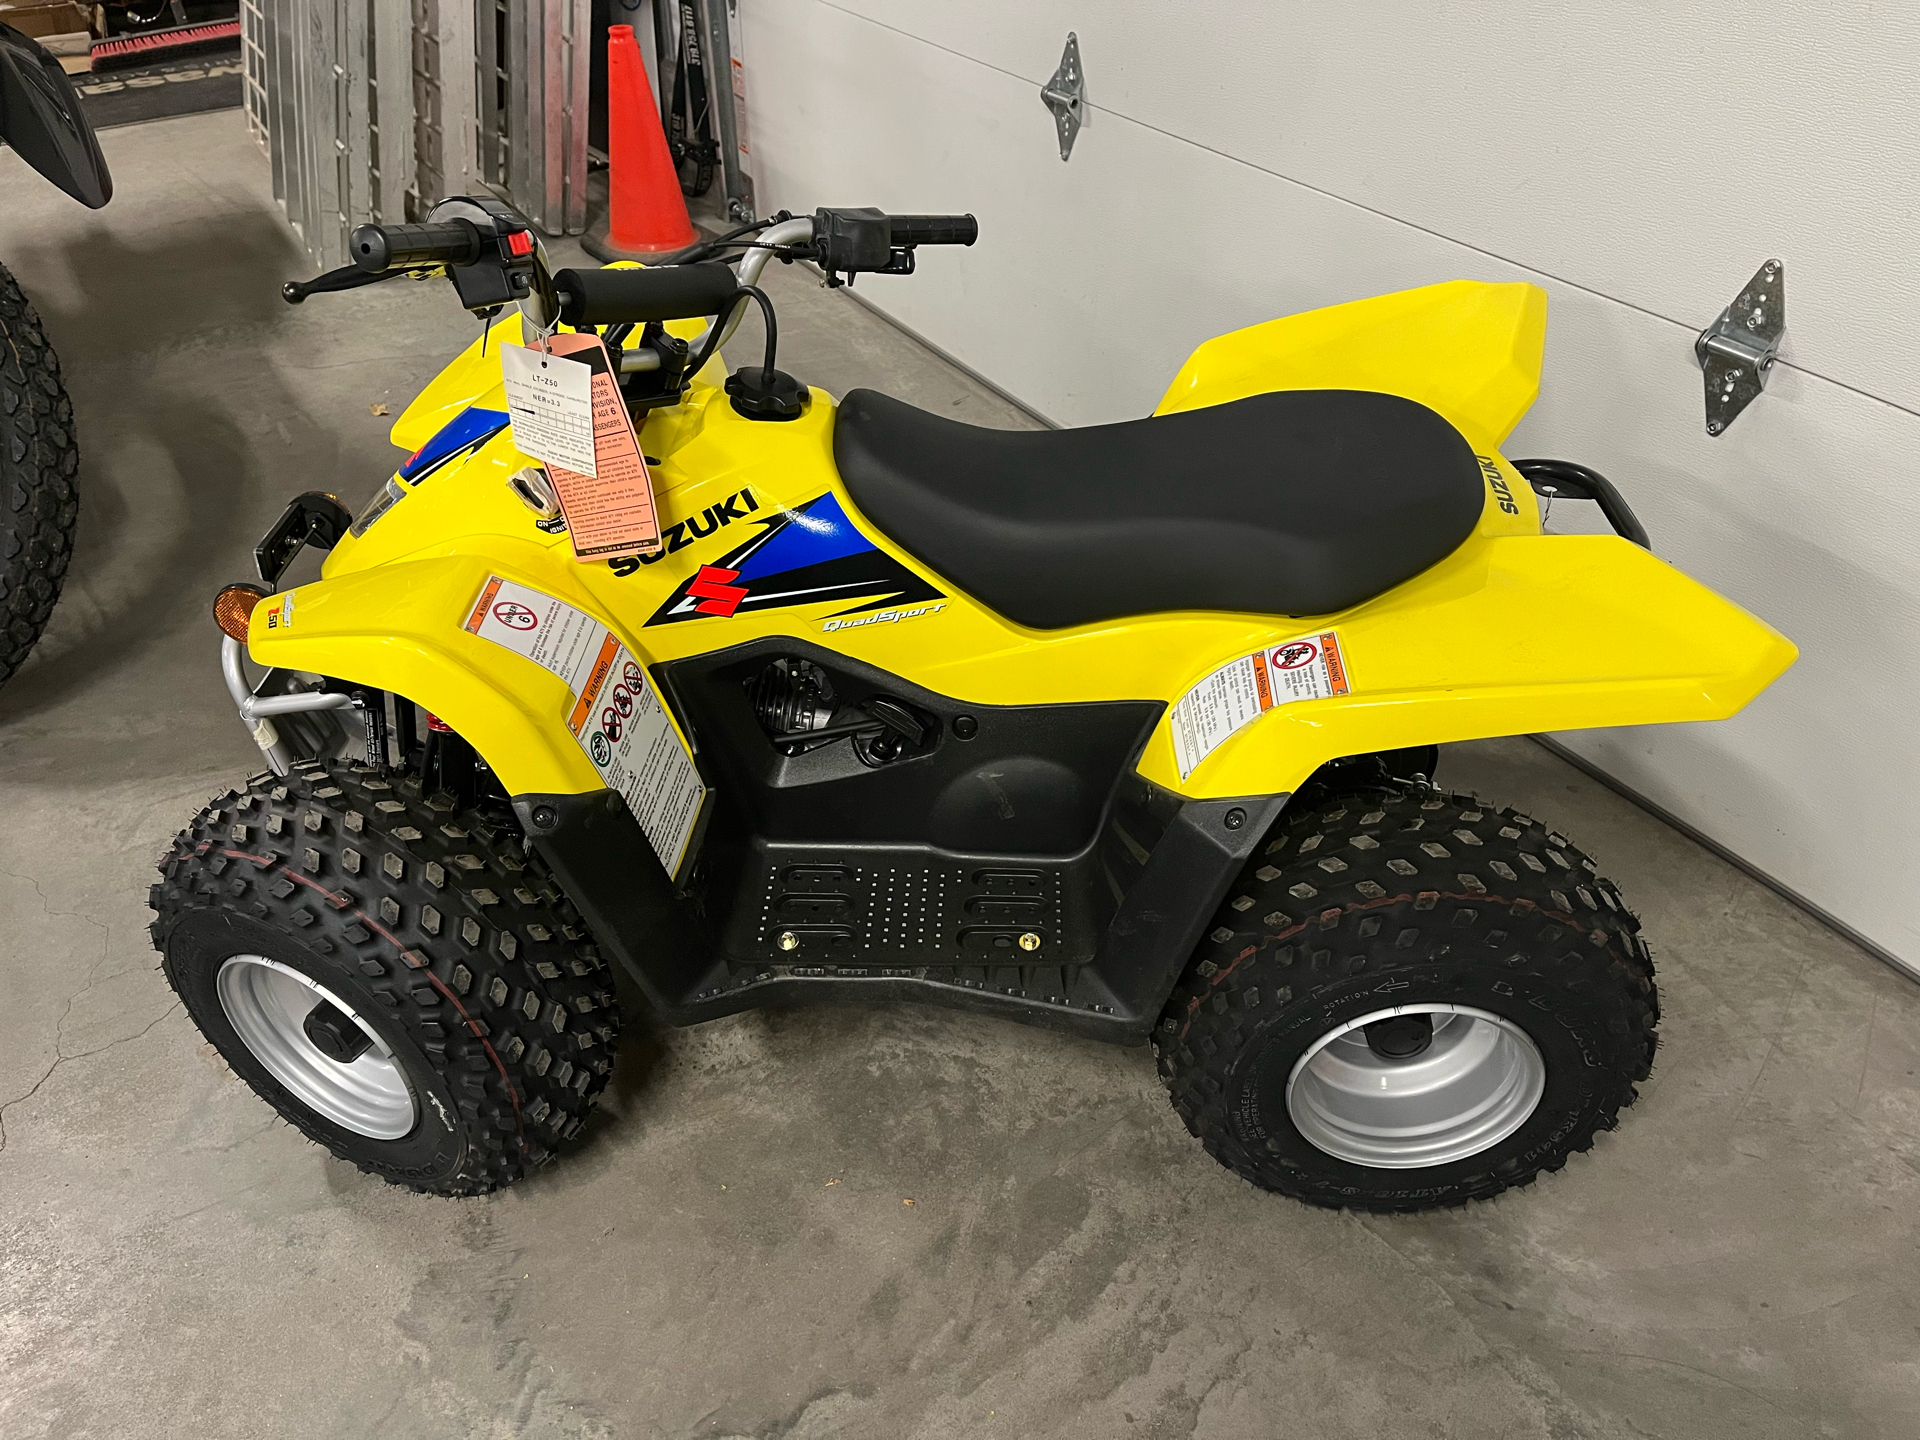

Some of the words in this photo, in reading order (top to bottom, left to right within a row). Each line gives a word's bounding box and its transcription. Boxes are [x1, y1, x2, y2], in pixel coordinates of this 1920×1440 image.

[532, 374, 558, 387] LT-Z50
[1474, 455, 1519, 515] SUZUKI
[550, 524, 567, 533] IGNIT
[608, 488, 760, 577] SUZUKI
[479, 591, 494, 611] WARNING
[268, 607, 280, 629] Z50
[503, 604, 518, 623] UNDER
[517, 614, 530, 624] 6
[822, 602, 946, 632] QuadSport
[1325, 651, 1341, 681] WARNING
[587, 658, 608, 699] WARNING
[1257, 670, 1268, 699] WARNING
[1322, 990, 1370, 1010] ROTATION
